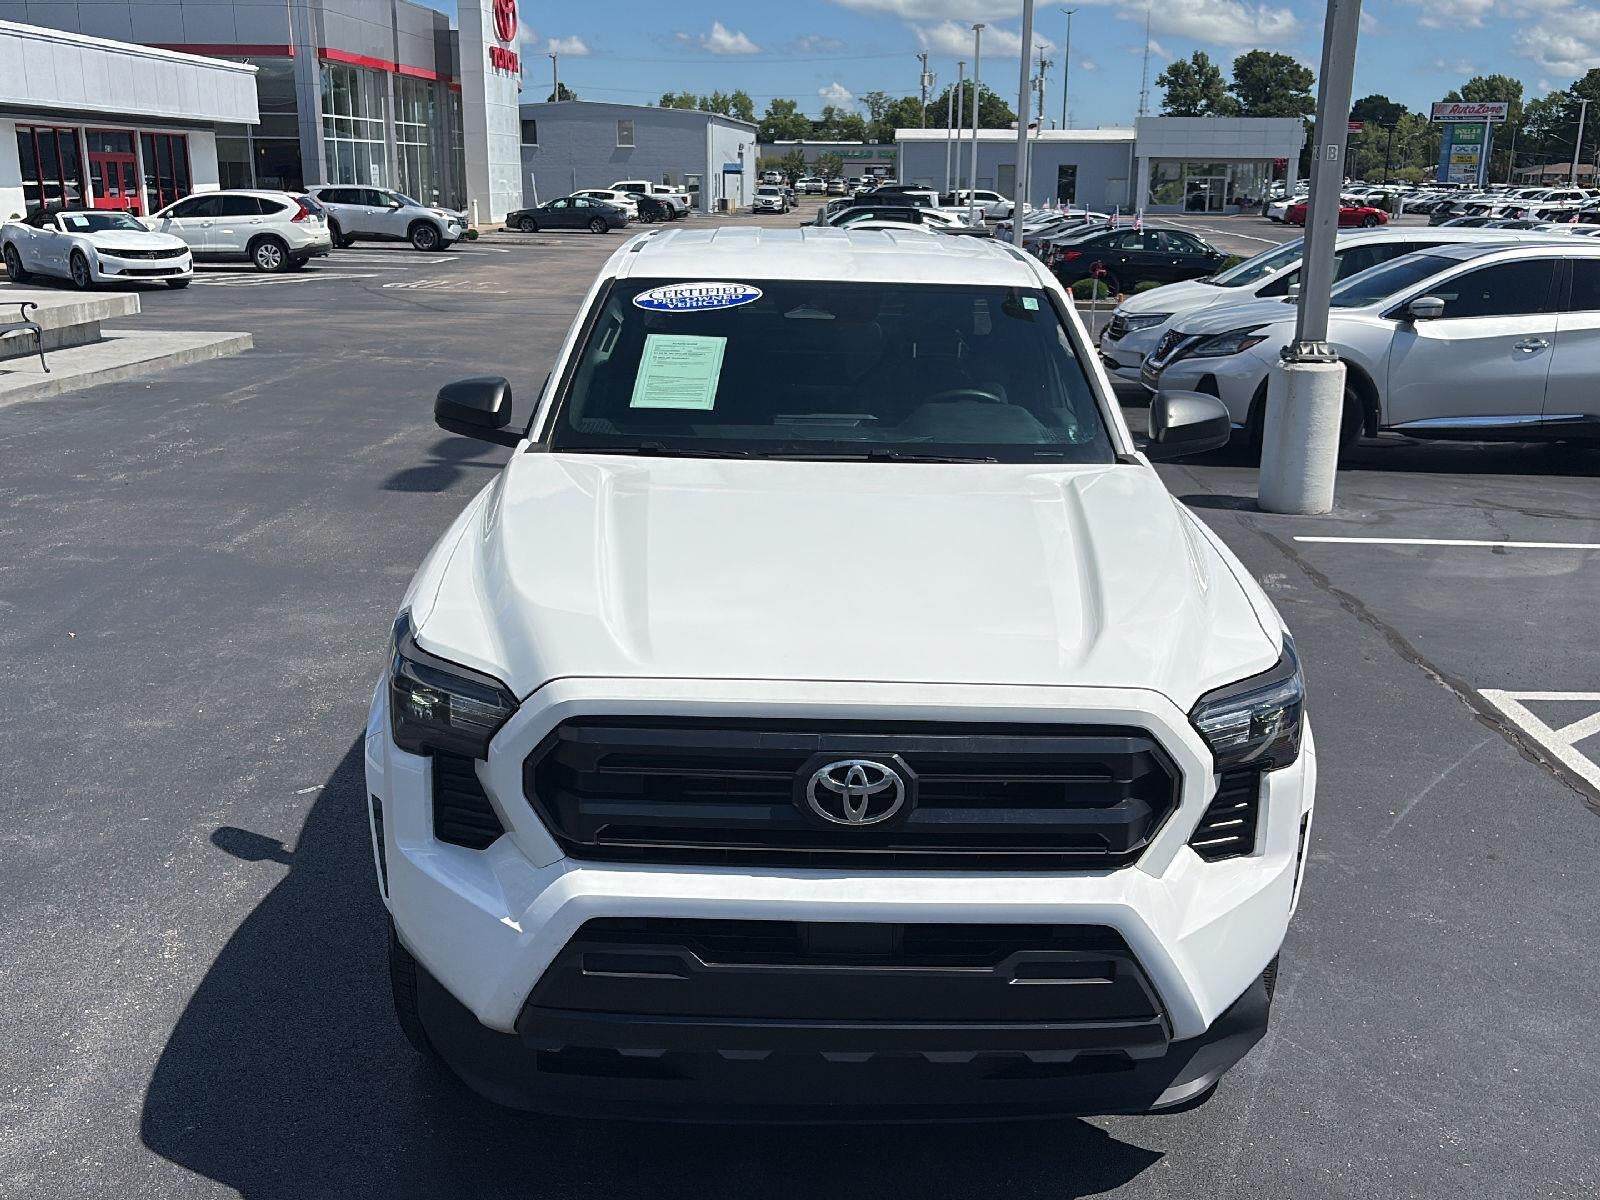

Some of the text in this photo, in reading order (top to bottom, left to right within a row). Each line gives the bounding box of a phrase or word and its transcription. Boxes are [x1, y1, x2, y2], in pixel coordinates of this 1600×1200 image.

[1449, 103, 1503, 114] AutoZone
[649, 287, 747, 299] CERTIFIED
[667, 298, 730, 309] VEHICLE
